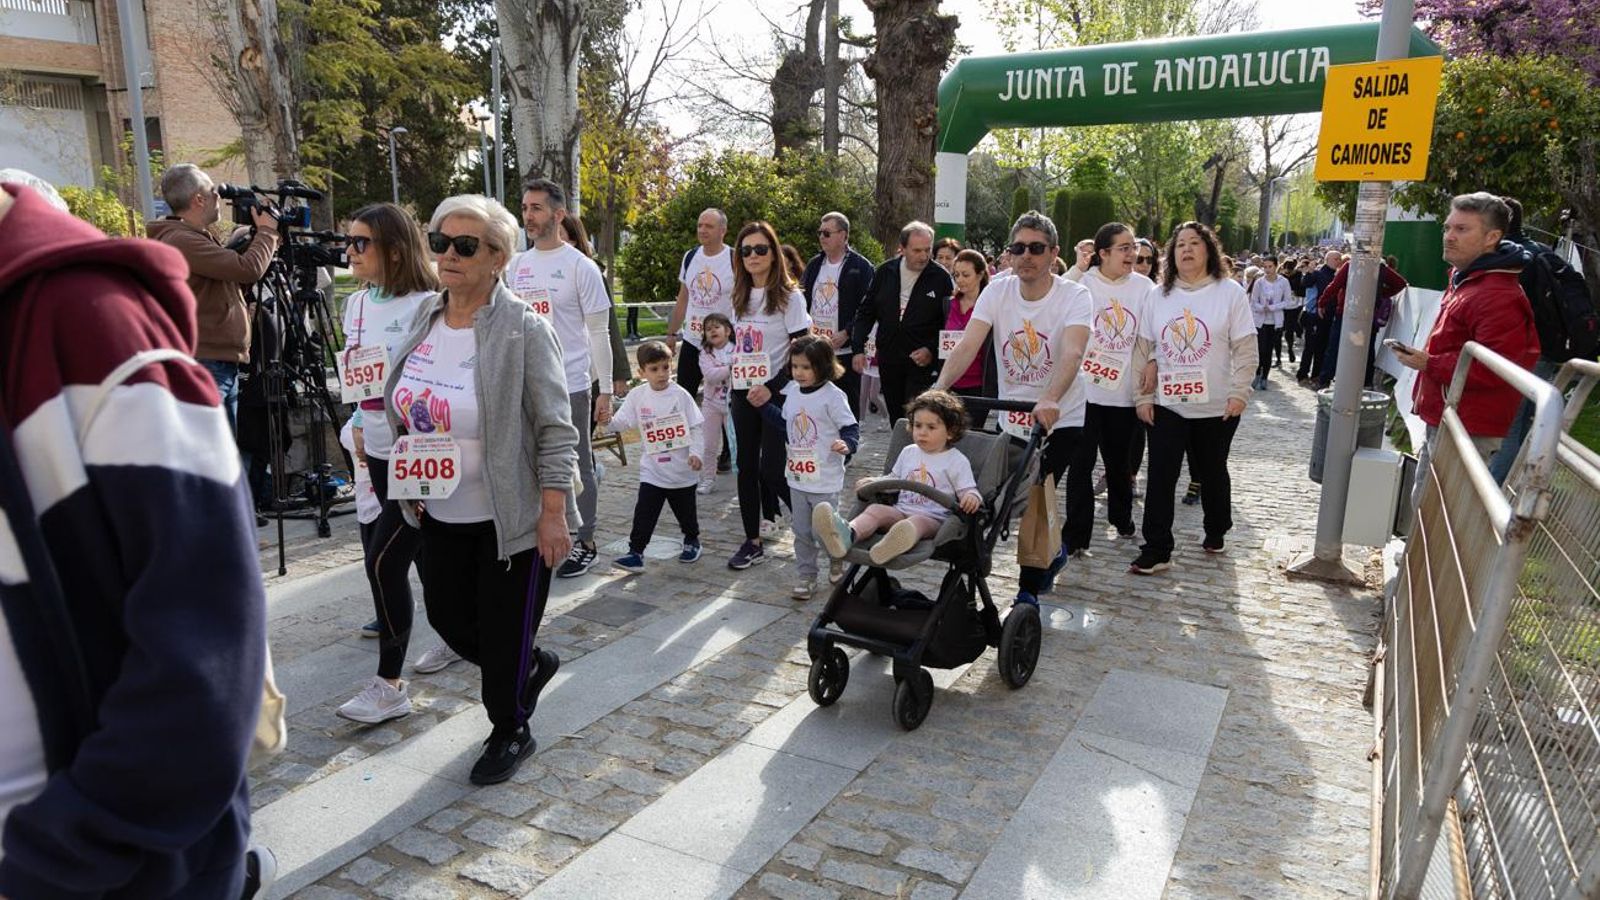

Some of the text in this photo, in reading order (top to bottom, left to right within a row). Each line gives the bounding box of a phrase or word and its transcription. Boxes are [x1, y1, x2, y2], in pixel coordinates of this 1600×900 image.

[999, 66, 1086, 101] JUNTA
[1103, 62, 1138, 95] DE
[1353, 73, 1409, 98] SALIDA
[1367, 108, 1388, 130] DE
[1331, 142, 1412, 166] CAMIONES
[344, 361, 385, 387] 5597
[733, 365, 767, 380] 5126
[1083, 359, 1120, 381] 5245
[1163, 381, 1204, 396] 5255
[646, 425, 686, 443] 5595
[394, 457, 455, 481] 5408
